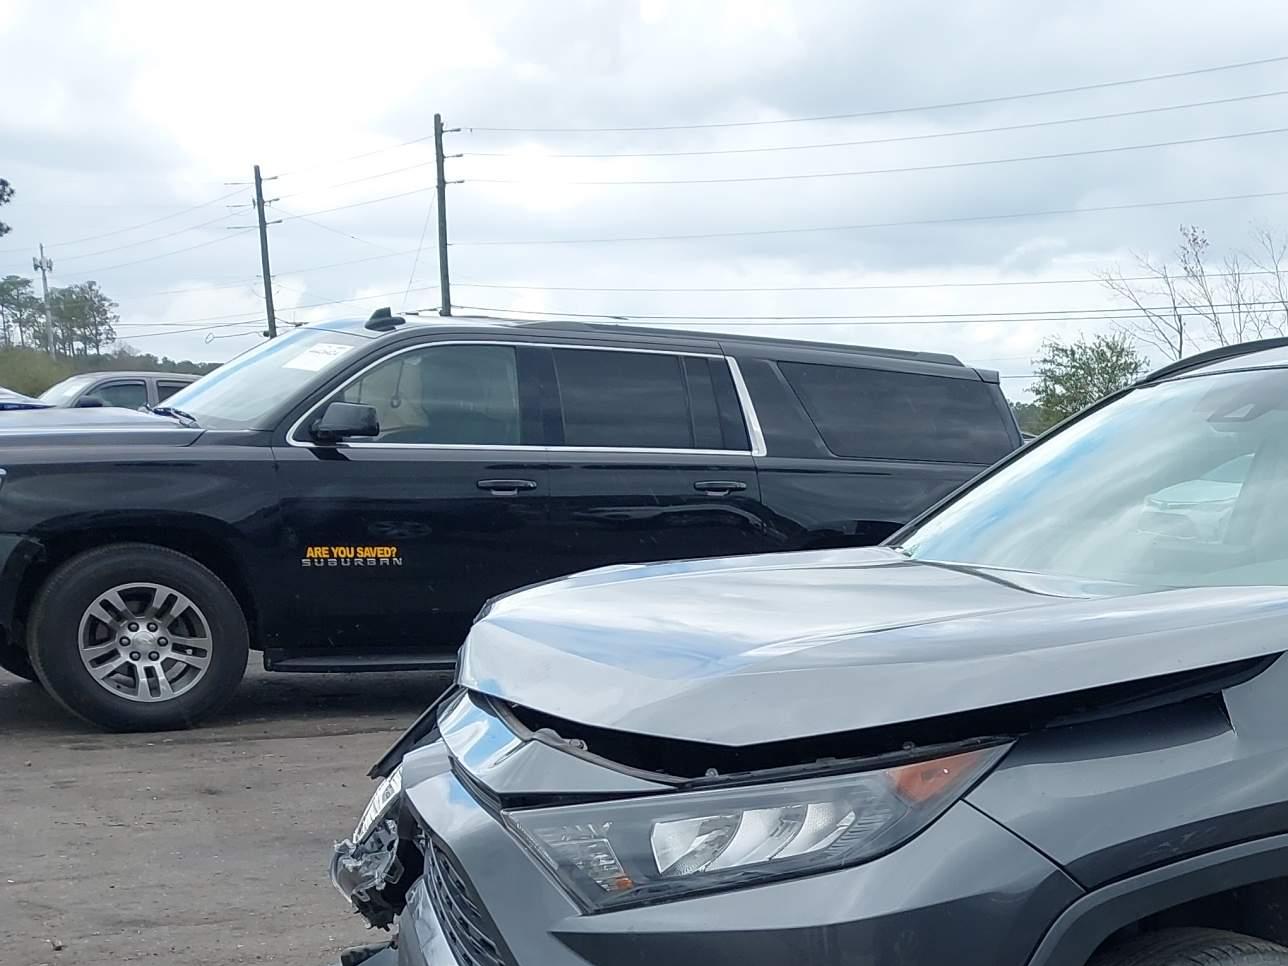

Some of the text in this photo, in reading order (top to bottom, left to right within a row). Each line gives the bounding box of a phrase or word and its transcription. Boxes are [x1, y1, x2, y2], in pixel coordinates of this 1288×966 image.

[306, 546, 398, 558] ARE YOU SAVED?
[301, 558, 403, 567] SUBURBAN
